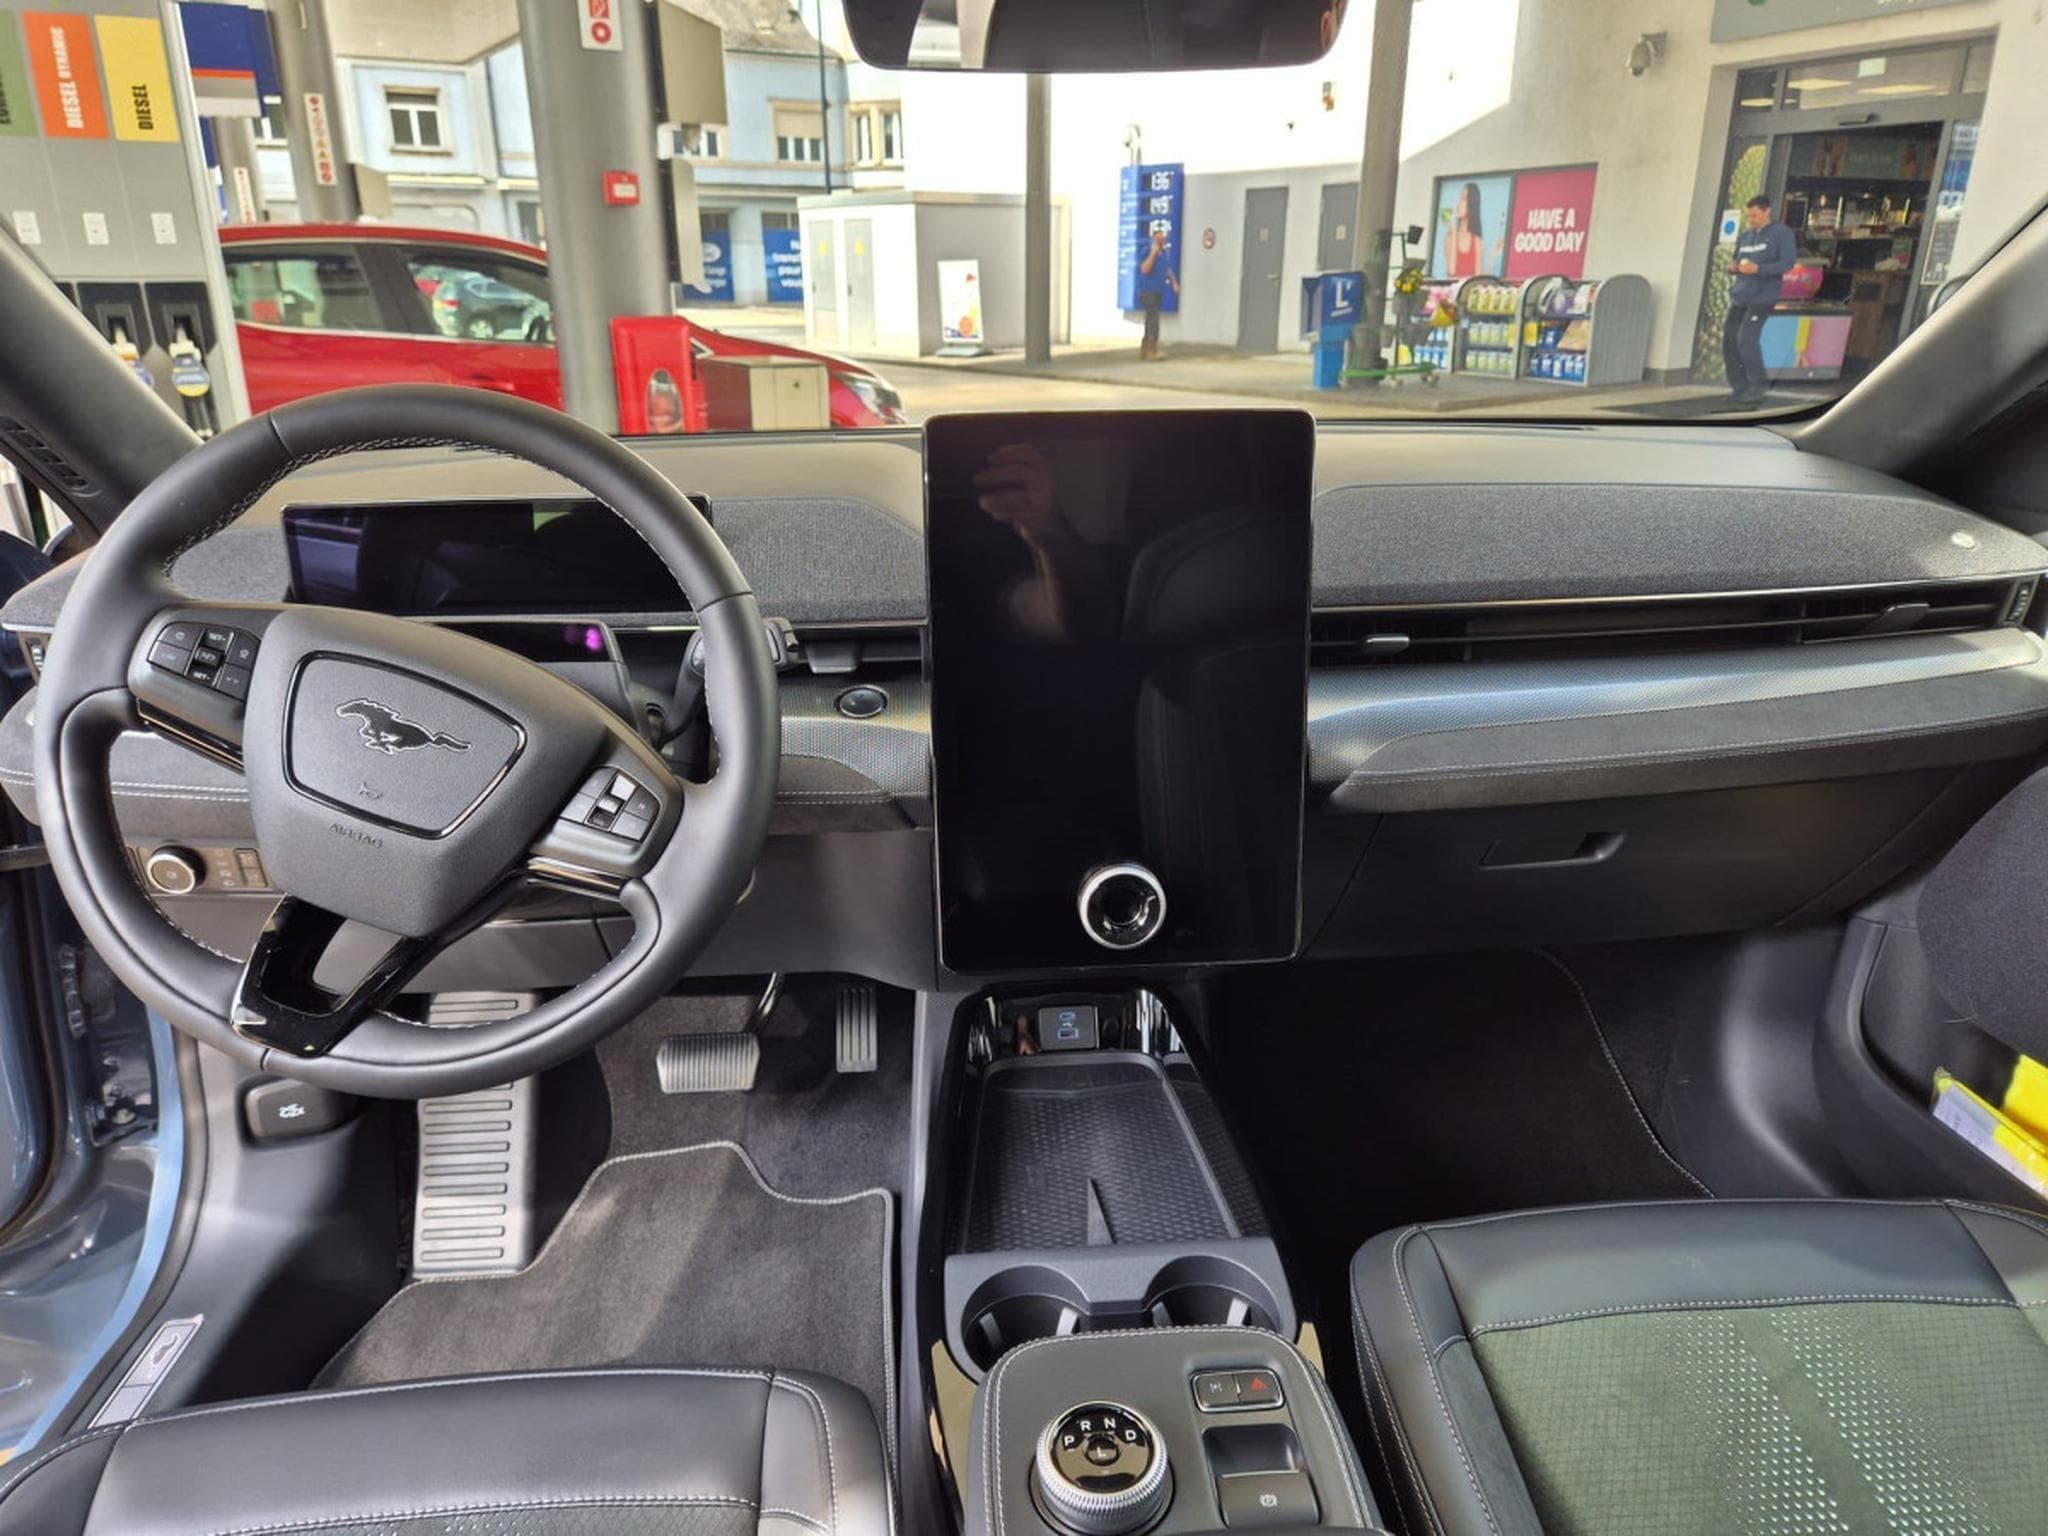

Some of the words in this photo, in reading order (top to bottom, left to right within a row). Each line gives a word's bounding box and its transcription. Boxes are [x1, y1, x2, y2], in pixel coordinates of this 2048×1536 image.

[58, 81, 84, 129] DIESEL
[131, 84, 154, 130] DIESEL
[1527, 208, 1564, 230] HAVE
[1564, 207, 1576, 229] A
[1514, 231, 1553, 253] GOOD
[1555, 231, 1585, 253] DAY
[1063, 1434, 1075, 1447] P
[1080, 1420, 1092, 1432] R
[1103, 1417, 1116, 1430] N
[1124, 1429, 1137, 1441] D
